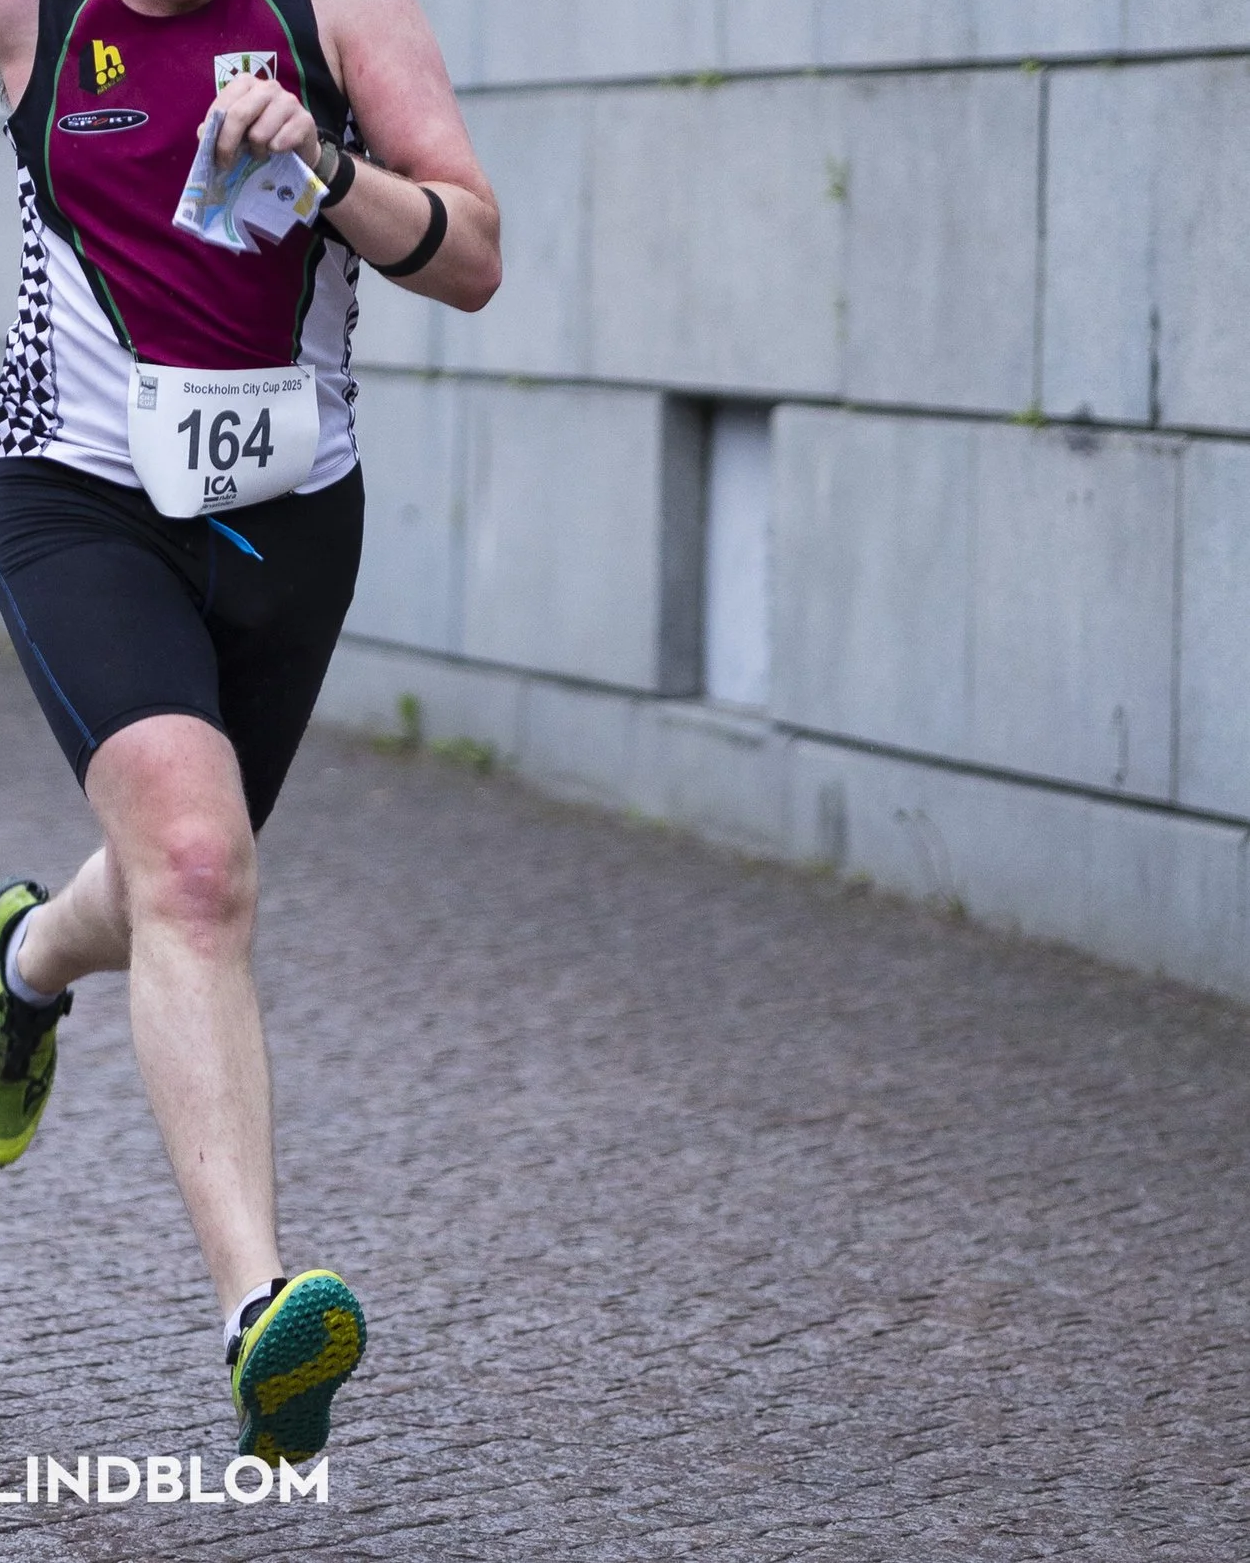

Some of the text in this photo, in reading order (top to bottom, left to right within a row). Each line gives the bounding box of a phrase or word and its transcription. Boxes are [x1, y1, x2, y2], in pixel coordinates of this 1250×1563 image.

[183, 379, 302, 396] Stockholm City Cup 2025
[177, 407, 274, 471] 164
[204, 475, 238, 495] ICA
